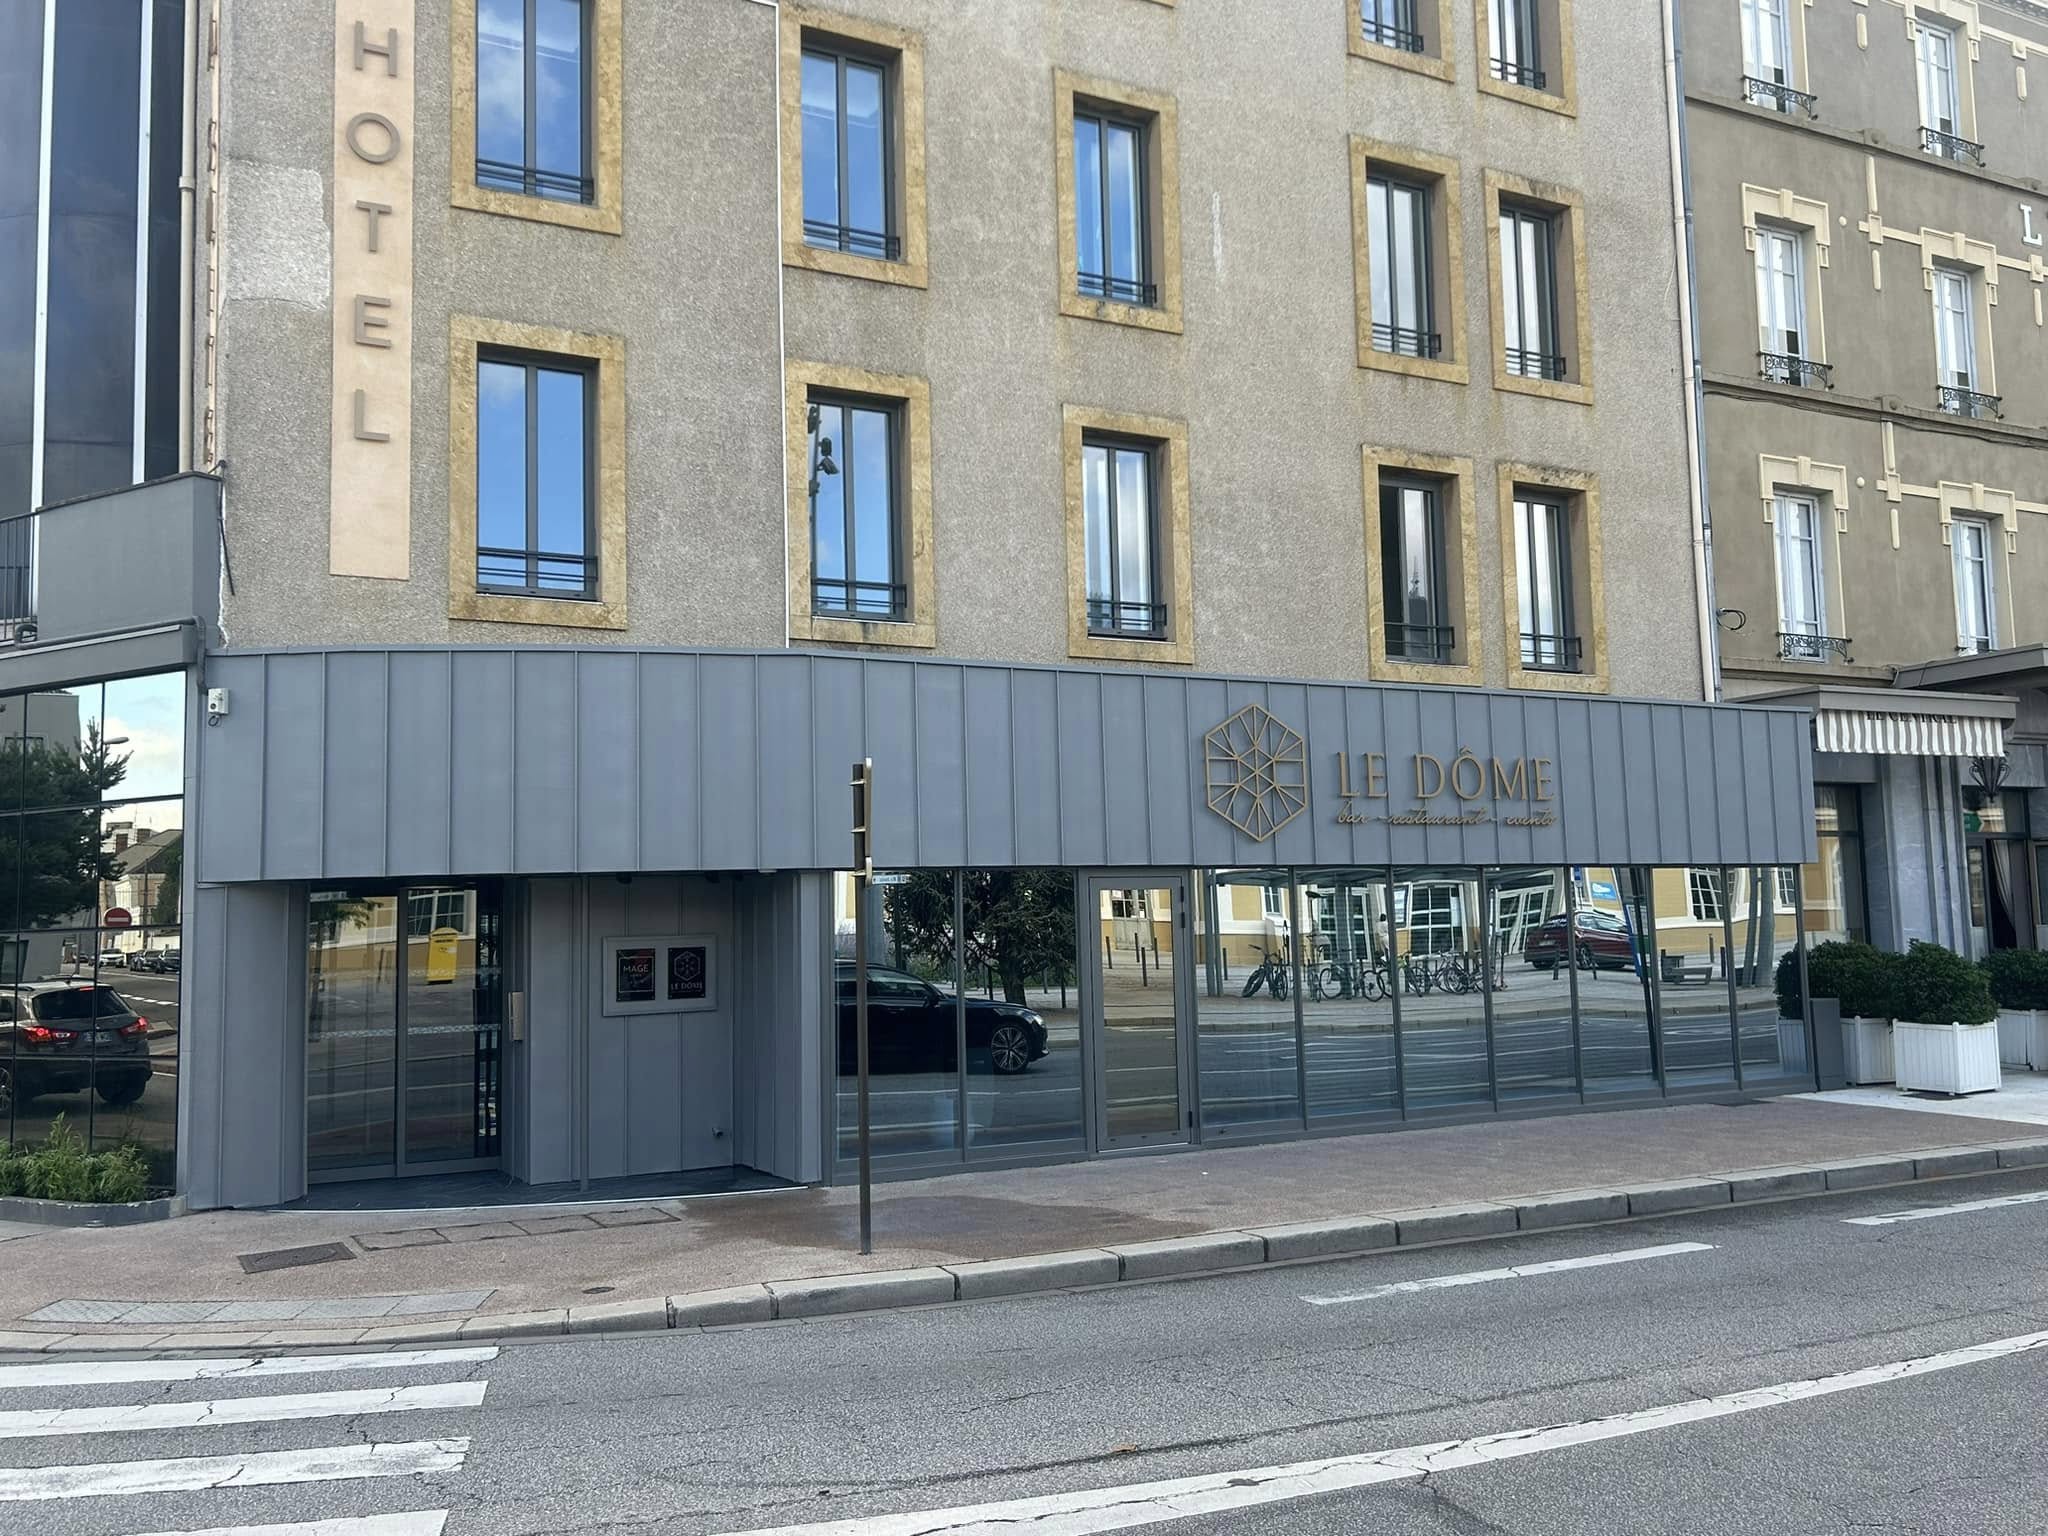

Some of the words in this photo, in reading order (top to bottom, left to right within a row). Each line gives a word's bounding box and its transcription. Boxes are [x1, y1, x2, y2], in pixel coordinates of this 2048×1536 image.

[346, 20, 401, 442] HOTEL
[1336, 751, 1389, 799] LE
[1415, 745, 1556, 802] DÔME
[1337, 799, 1369, 825] bar
[1389, 808, 1486, 826] restaurant
